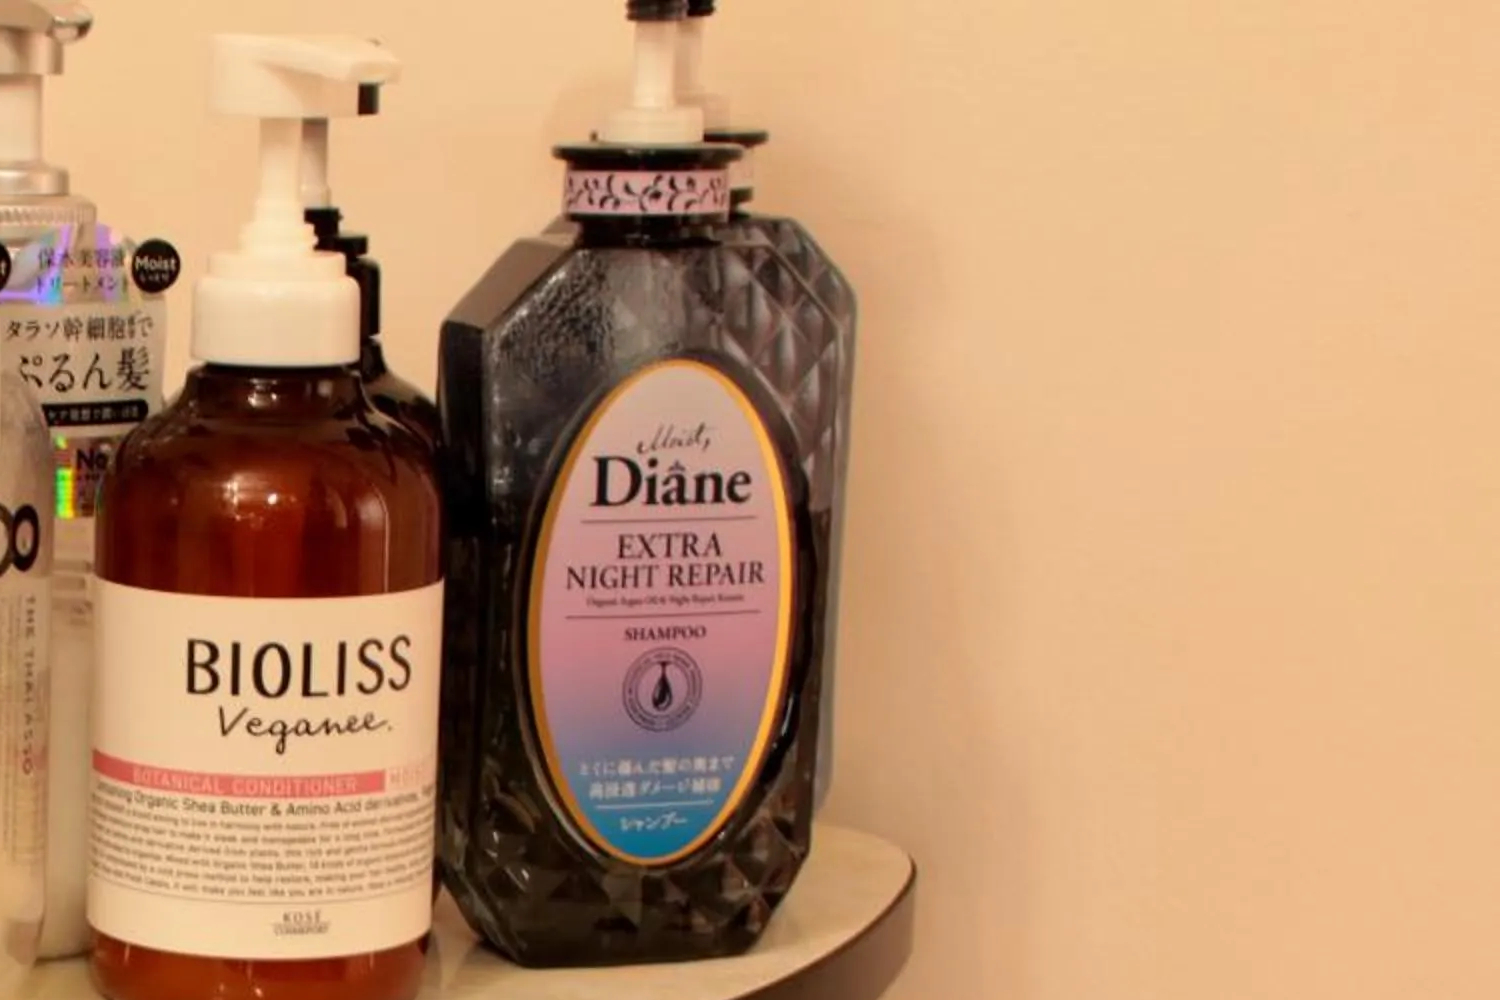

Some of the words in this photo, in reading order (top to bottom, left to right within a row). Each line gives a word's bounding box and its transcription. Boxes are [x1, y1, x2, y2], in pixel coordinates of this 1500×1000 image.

[134, 255, 178, 272] Moist
[589, 455, 753, 508] Diâne
[617, 531, 723, 560] EXTRA
[566, 563, 660, 591] NIGHT
[667, 560, 766, 588] REPAIR
[624, 624, 708, 642] SHAMPOO
[186, 634, 412, 699] BIOLISS
[132, 767, 224, 796] BOTANICAL
[230, 776, 359, 798] CONDITIONER
[134, 789, 179, 811] Organic
[181, 797, 216, 814] Shea
[220, 800, 267, 817] Butter
[269, 802, 283, 817] &
[285, 801, 331, 817] Amino
[333, 799, 363, 814] Acid
[620, 811, 689, 832] シャンプー
